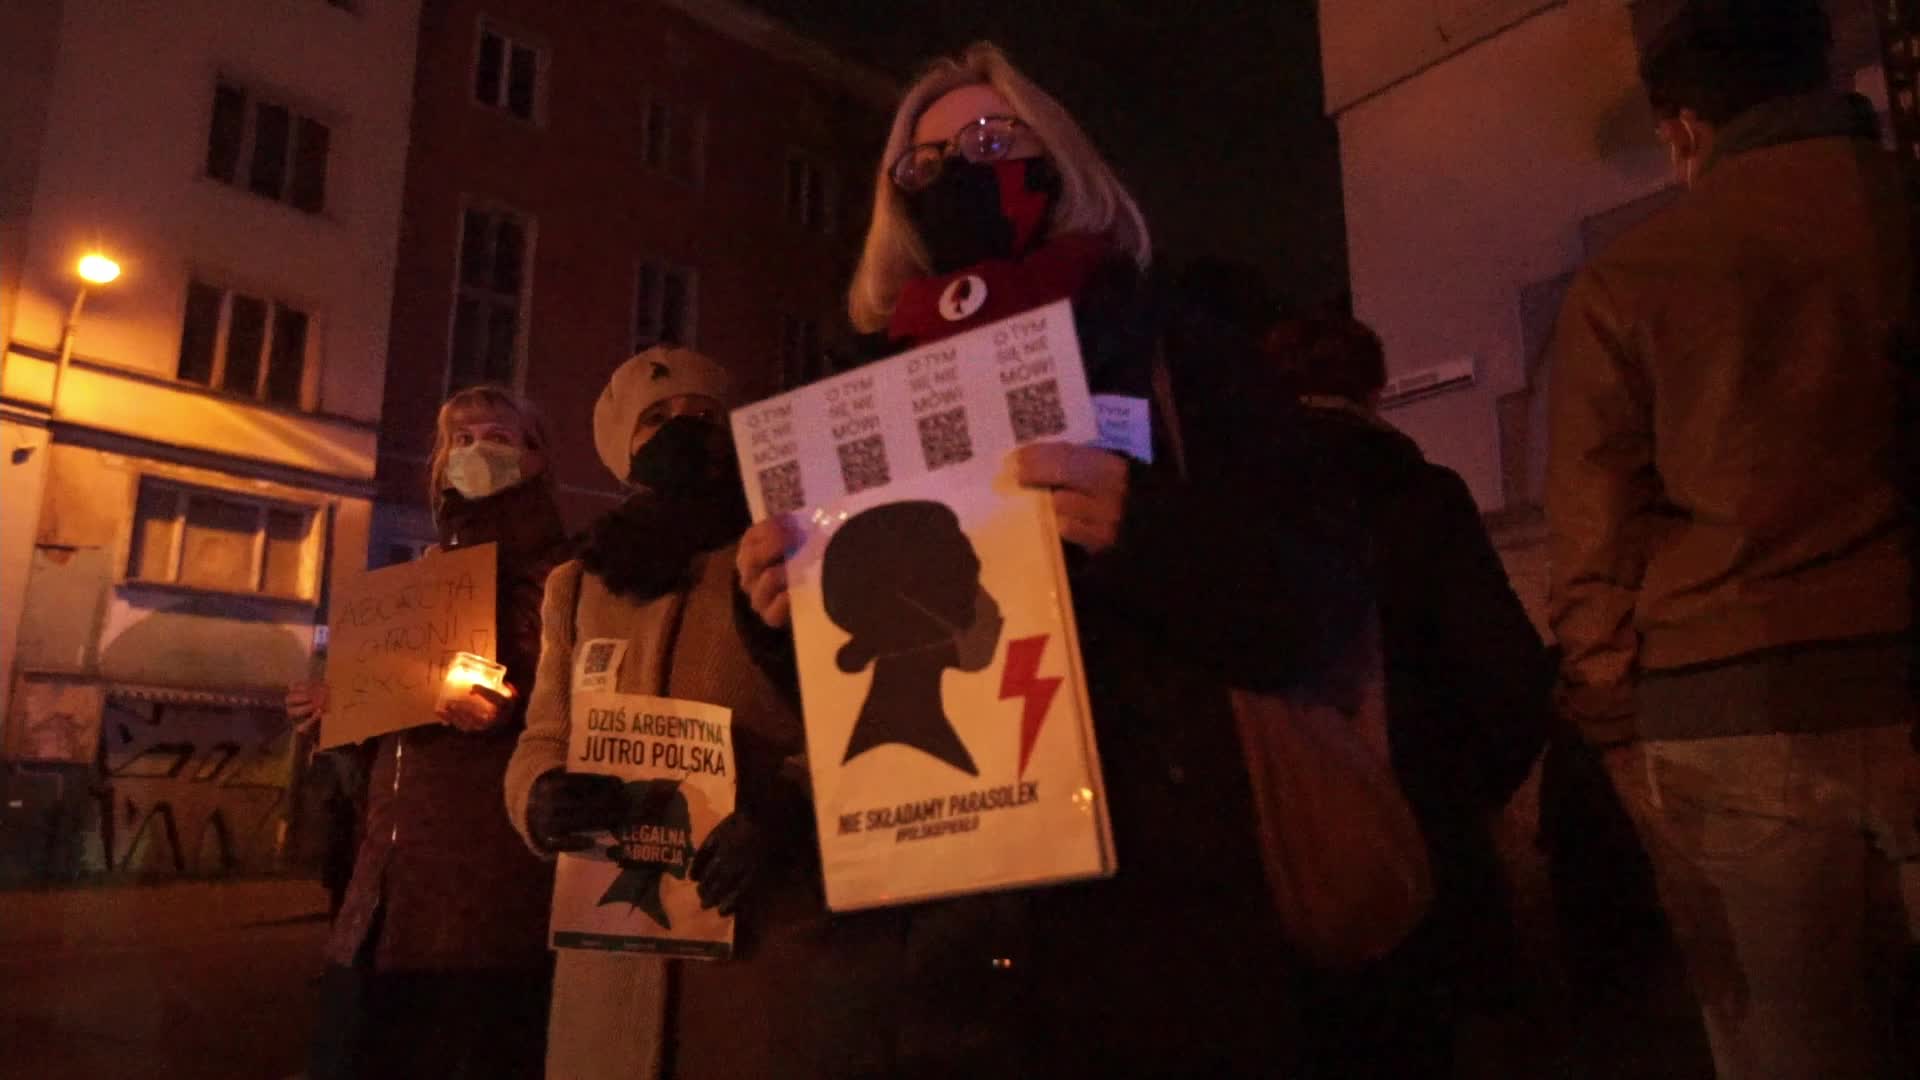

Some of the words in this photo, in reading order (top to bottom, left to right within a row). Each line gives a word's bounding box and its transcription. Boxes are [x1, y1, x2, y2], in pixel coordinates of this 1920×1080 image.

[1010, 318, 1047, 340] TYM
[587, 707, 626, 733] DZIŚ
[631, 711, 724, 746] ARGENTYNA
[580, 736, 645, 766] JUTRO
[652, 744, 726, 777] POLSKA
[838, 812, 862, 836] NIE
[950, 780, 1039, 817] PARASOLEK
[622, 825, 687, 847] LEGALNA
